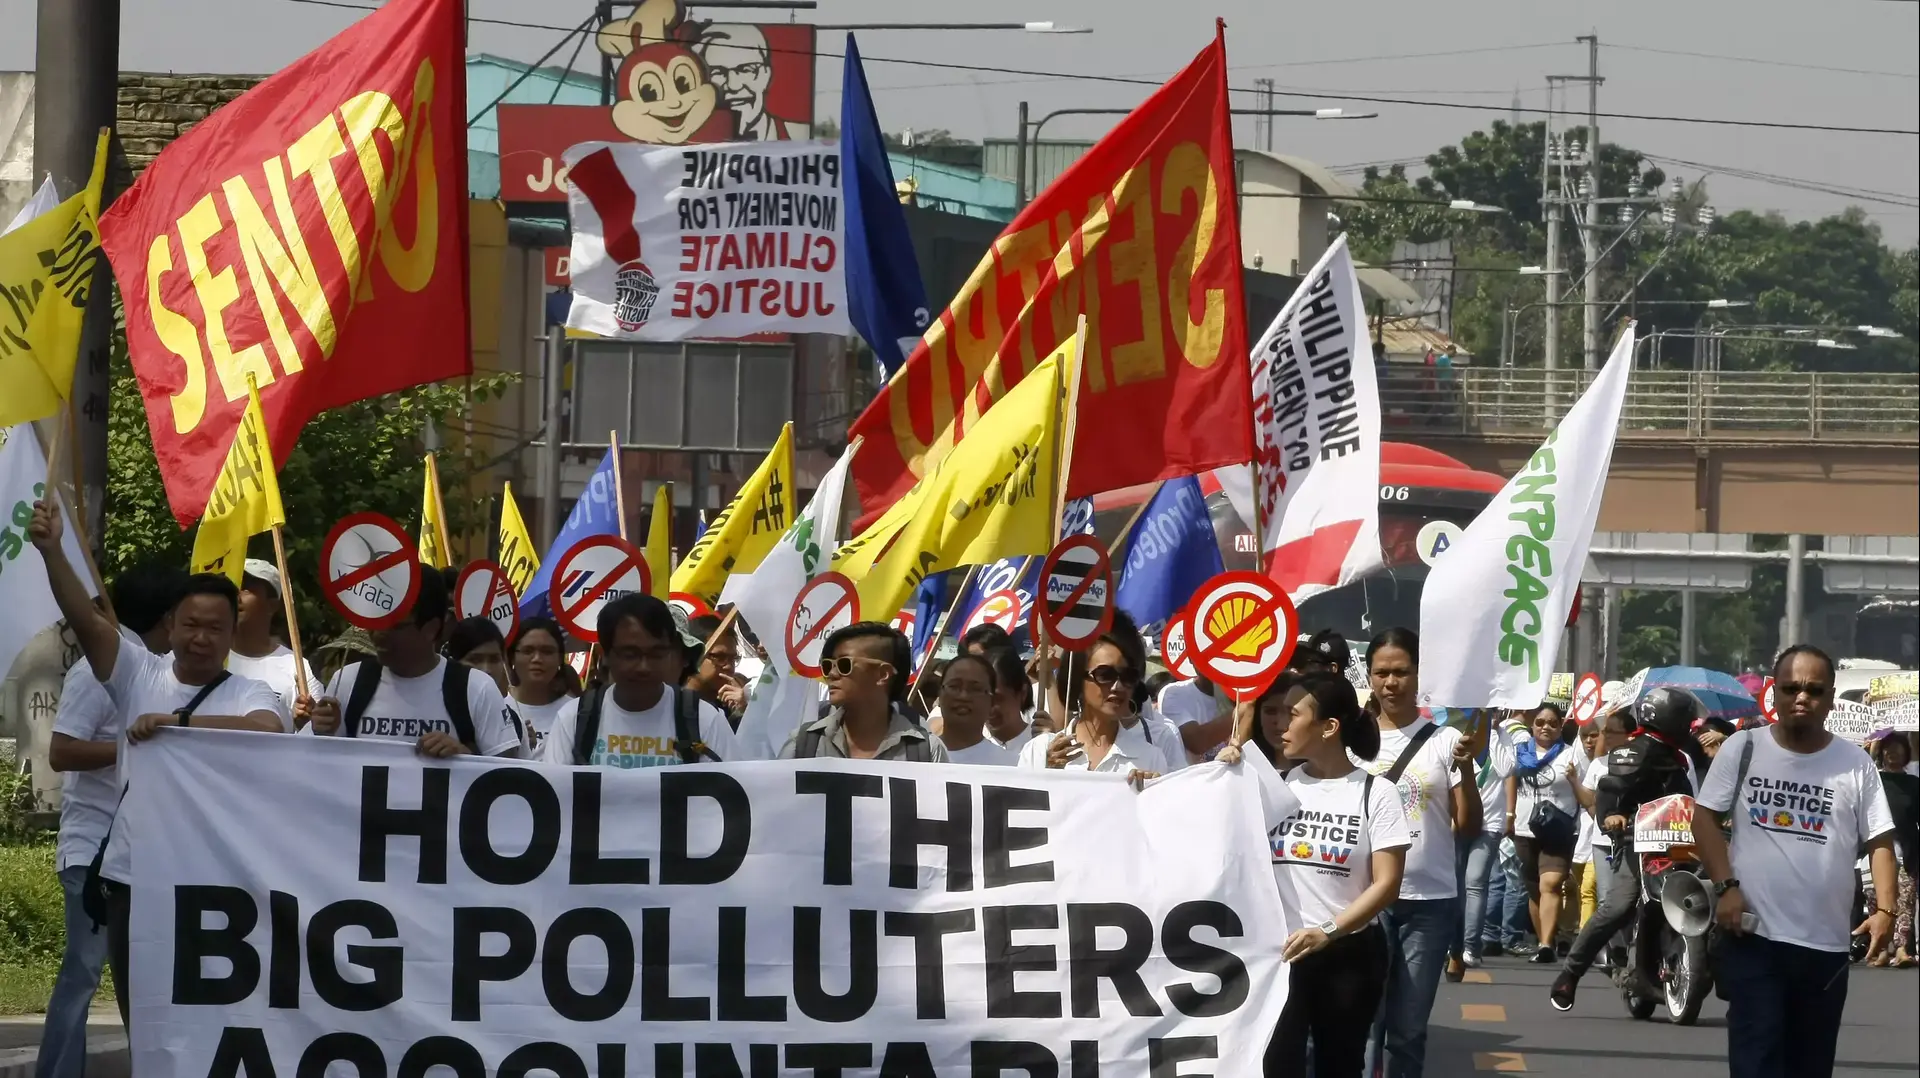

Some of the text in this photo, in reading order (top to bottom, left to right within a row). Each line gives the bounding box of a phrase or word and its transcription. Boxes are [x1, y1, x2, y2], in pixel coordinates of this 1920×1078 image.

[1298, 269, 1361, 462] PHILIPPINE
[337, 569, 394, 611] trata
[1832, 712, 1857, 720] DIRTY
[1849, 704, 1876, 716] COAL
[361, 716, 450, 737] DEFEND
[1749, 777, 1834, 799] CLIMATE
[1747, 790, 1833, 815] JUSTICE
[358, 765, 1055, 893] HOLD THE
[1286, 810, 1361, 827] IMATE
[1749, 807, 1825, 832] NOW
[1636, 830, 1680, 841] CLIMATE
[1270, 840, 1352, 865] NOW
[171, 885, 1251, 1022] BIG POLLUTERS
